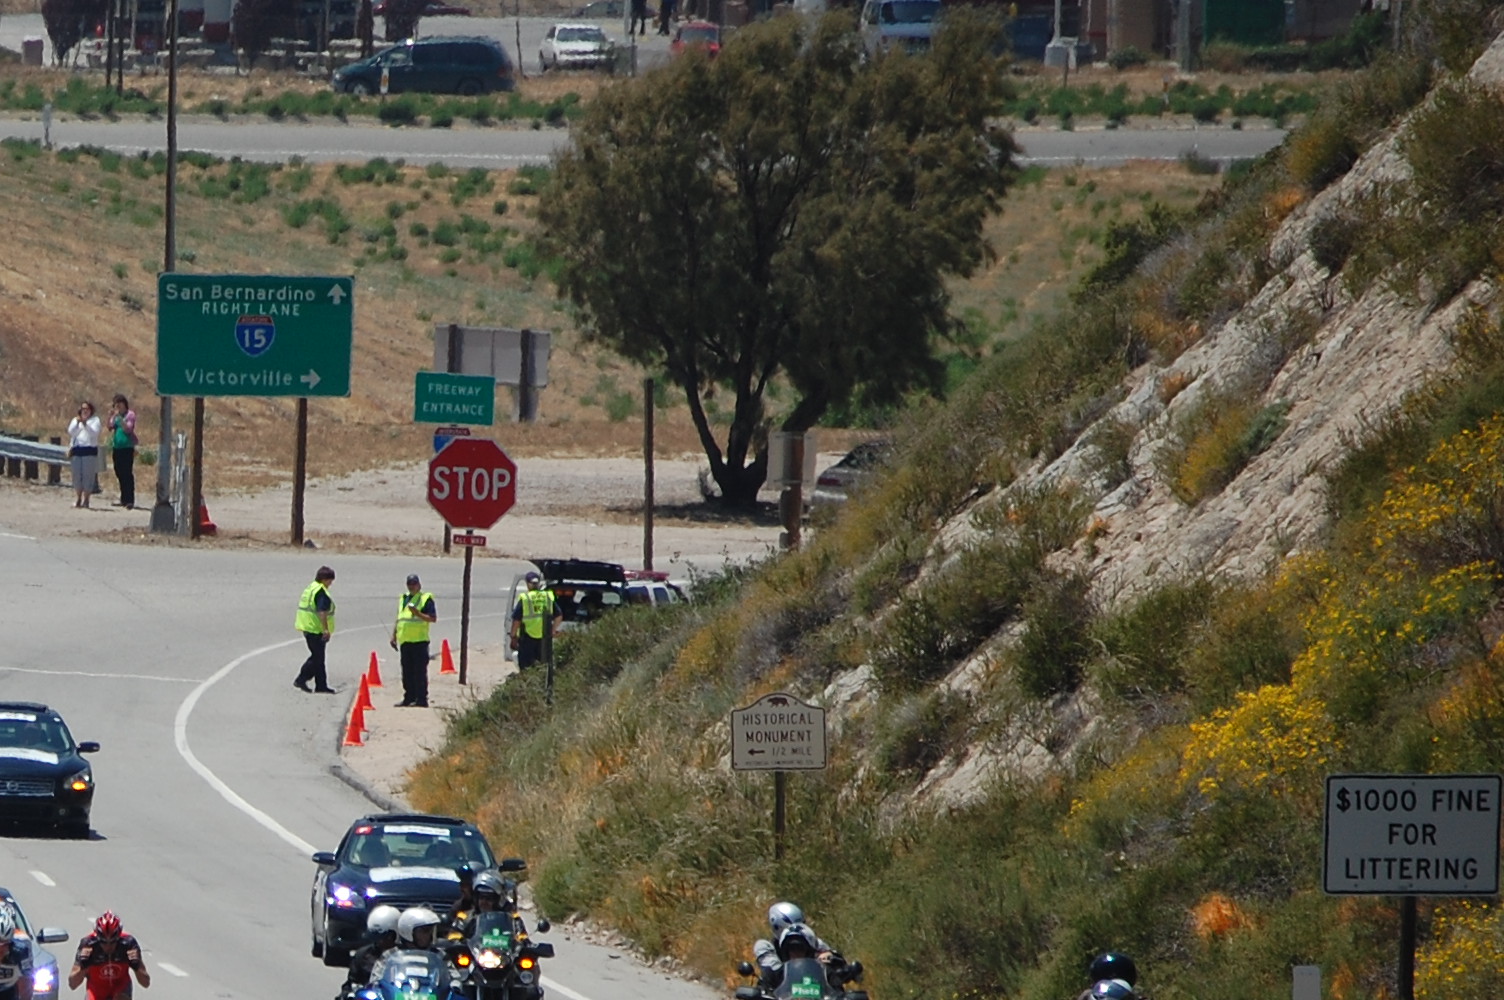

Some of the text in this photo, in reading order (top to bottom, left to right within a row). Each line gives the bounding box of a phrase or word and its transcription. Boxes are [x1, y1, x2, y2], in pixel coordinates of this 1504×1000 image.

[165, 283, 316, 301] San Bernardino
[202, 302, 300, 316] RIGHT LANE
[243, 328, 267, 348] 15
[185, 368, 293, 386] Victorville
[427, 382, 482, 397] FREEWAY
[422, 402, 485, 416] ENTRANCE
[432, 466, 511, 501] STOP
[742, 712, 815, 726] HISTORICAL
[746, 730, 812, 743] MONUMENT
[772, 746, 812, 756] 1/2 MILE
[1336, 786, 1491, 813] $1000 FINE
[1388, 823, 1437, 846] FOR
[1345, 857, 1479, 880] LITTERING
[482, 936, 507, 946] Photo
[792, 986, 820, 996] Photo
